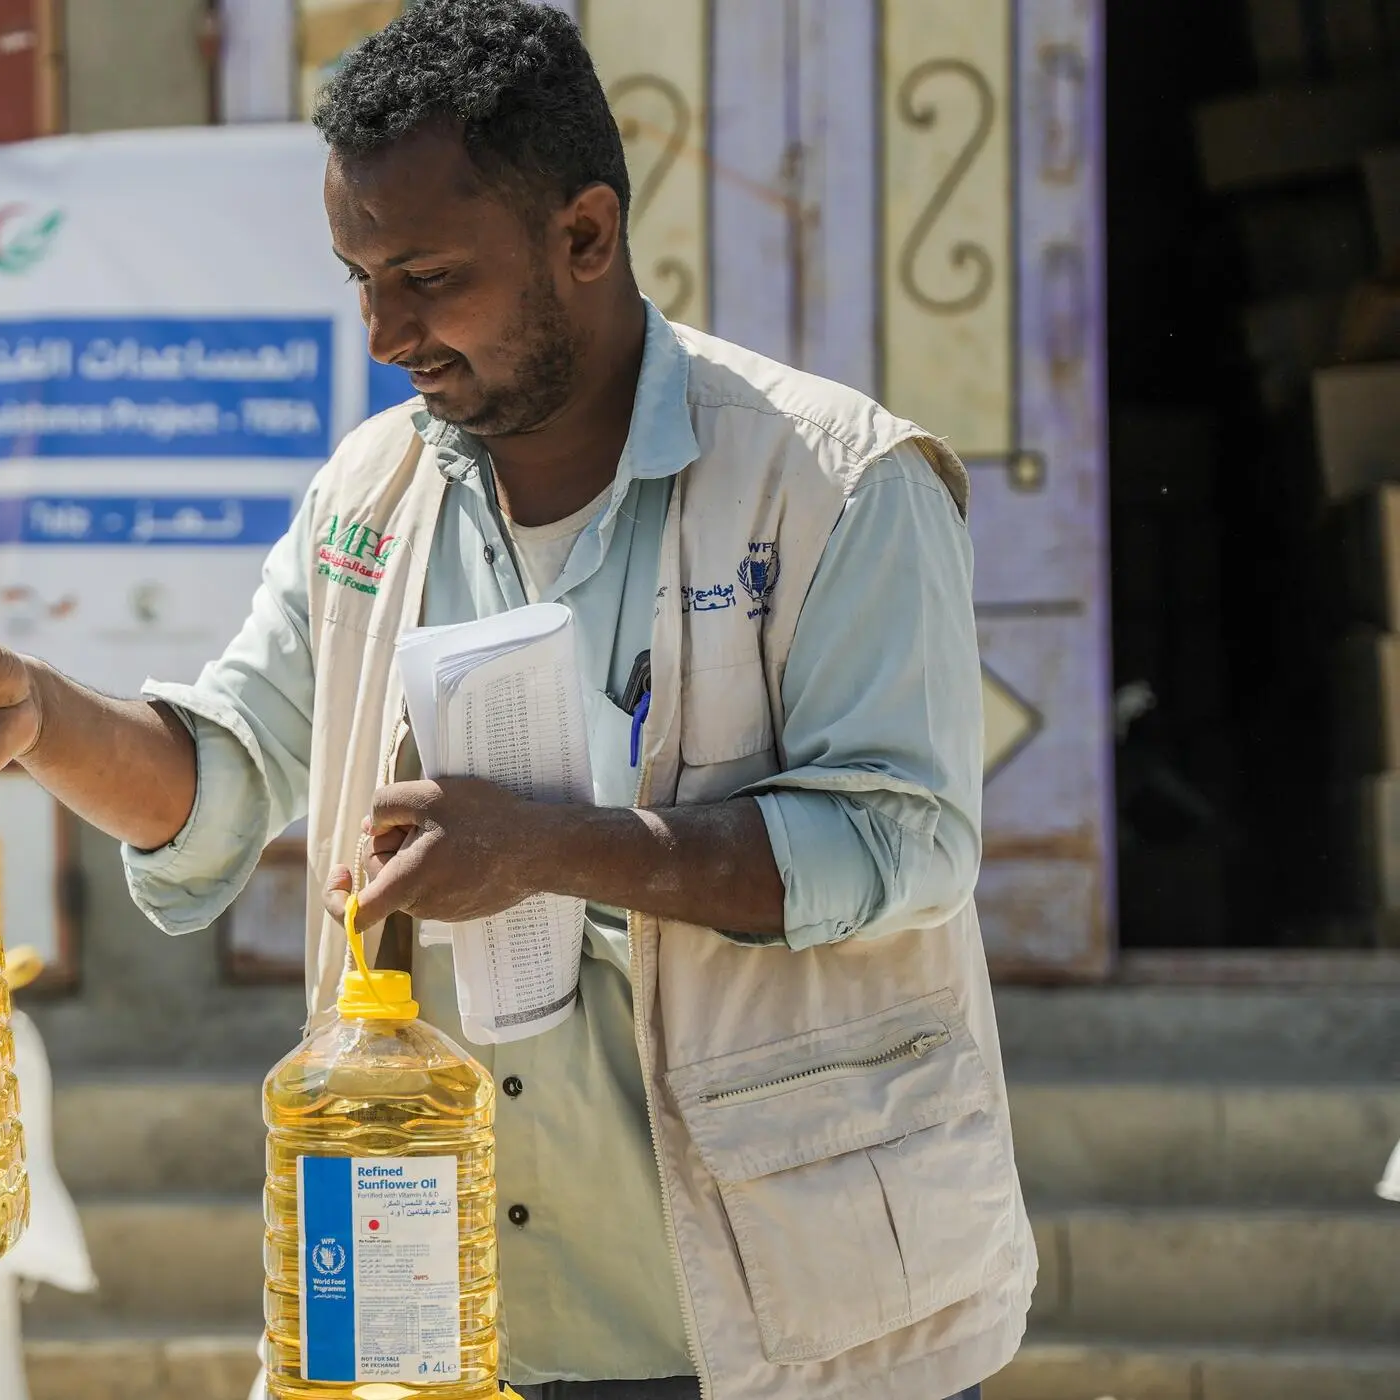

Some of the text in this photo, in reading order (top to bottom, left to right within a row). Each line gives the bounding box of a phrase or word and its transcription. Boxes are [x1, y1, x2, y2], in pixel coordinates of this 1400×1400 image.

[357, 1166, 403, 1177] Refined
[357, 1179, 437, 1190] Sunflower Oil
[313, 1285, 346, 1293] Programme
